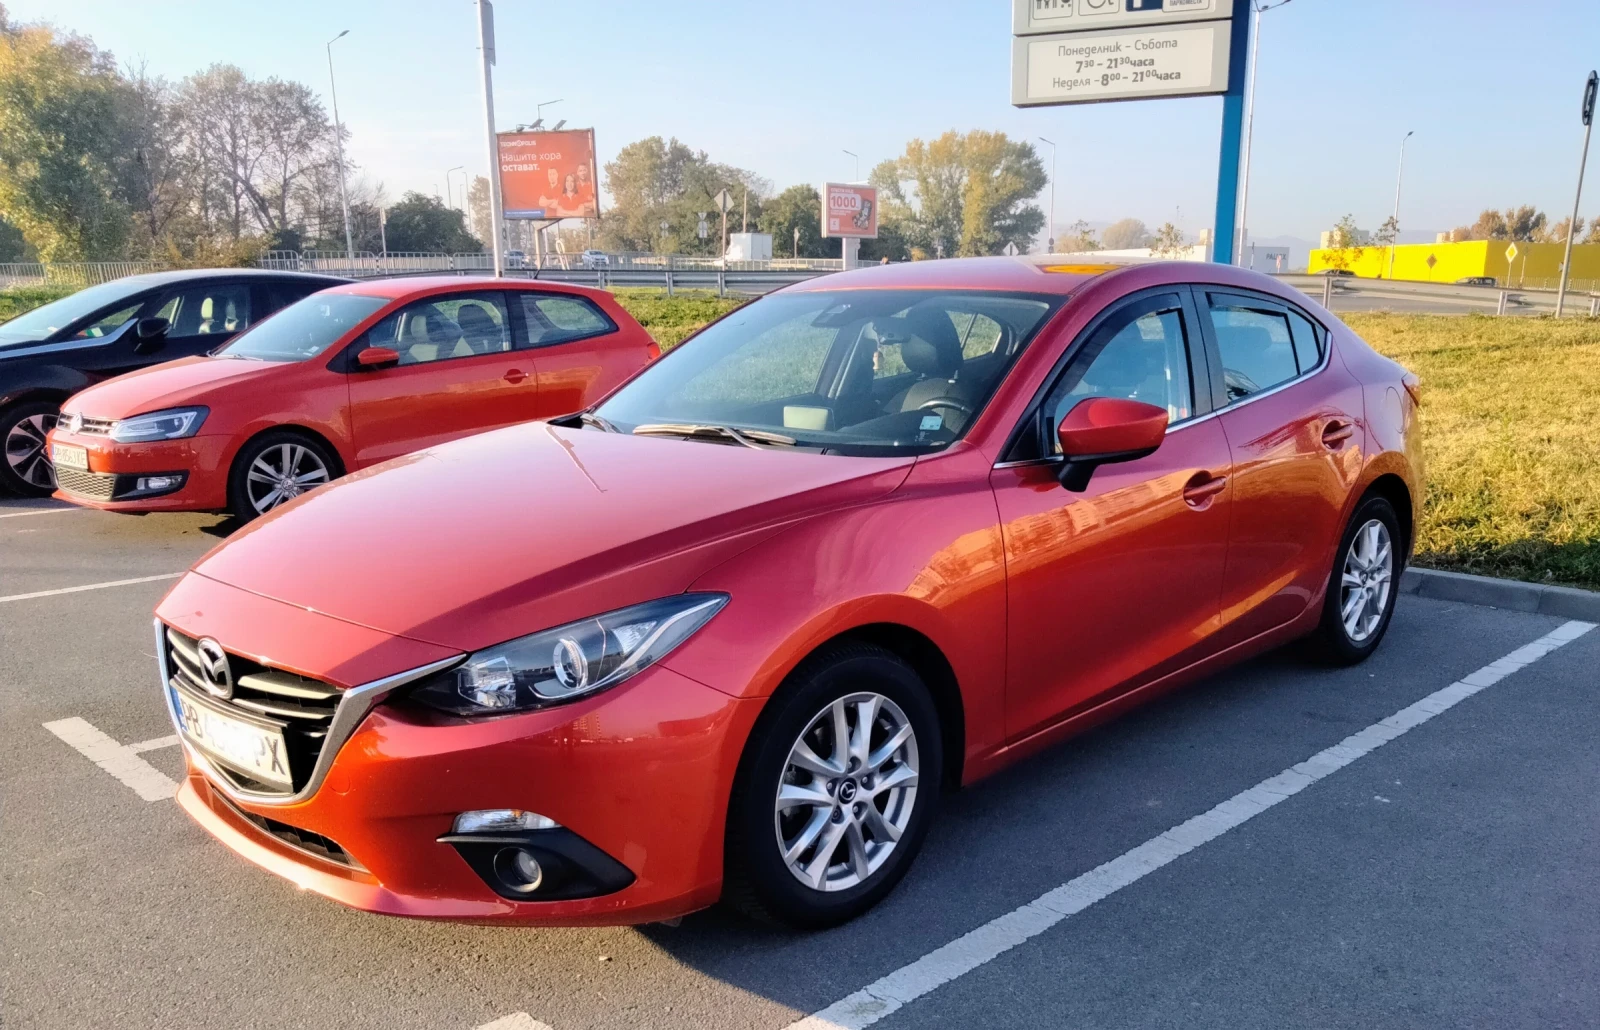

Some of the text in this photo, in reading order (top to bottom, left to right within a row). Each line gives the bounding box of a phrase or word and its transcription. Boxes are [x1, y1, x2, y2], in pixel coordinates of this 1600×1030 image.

[1058, 41, 1122, 58] Понеделник
[1134, 38, 1178, 51] Събота
[1052, 77, 1091, 91] Неделя
[501, 152, 562, 162] Нашите хора
[502, 163, 540, 172] остават.
